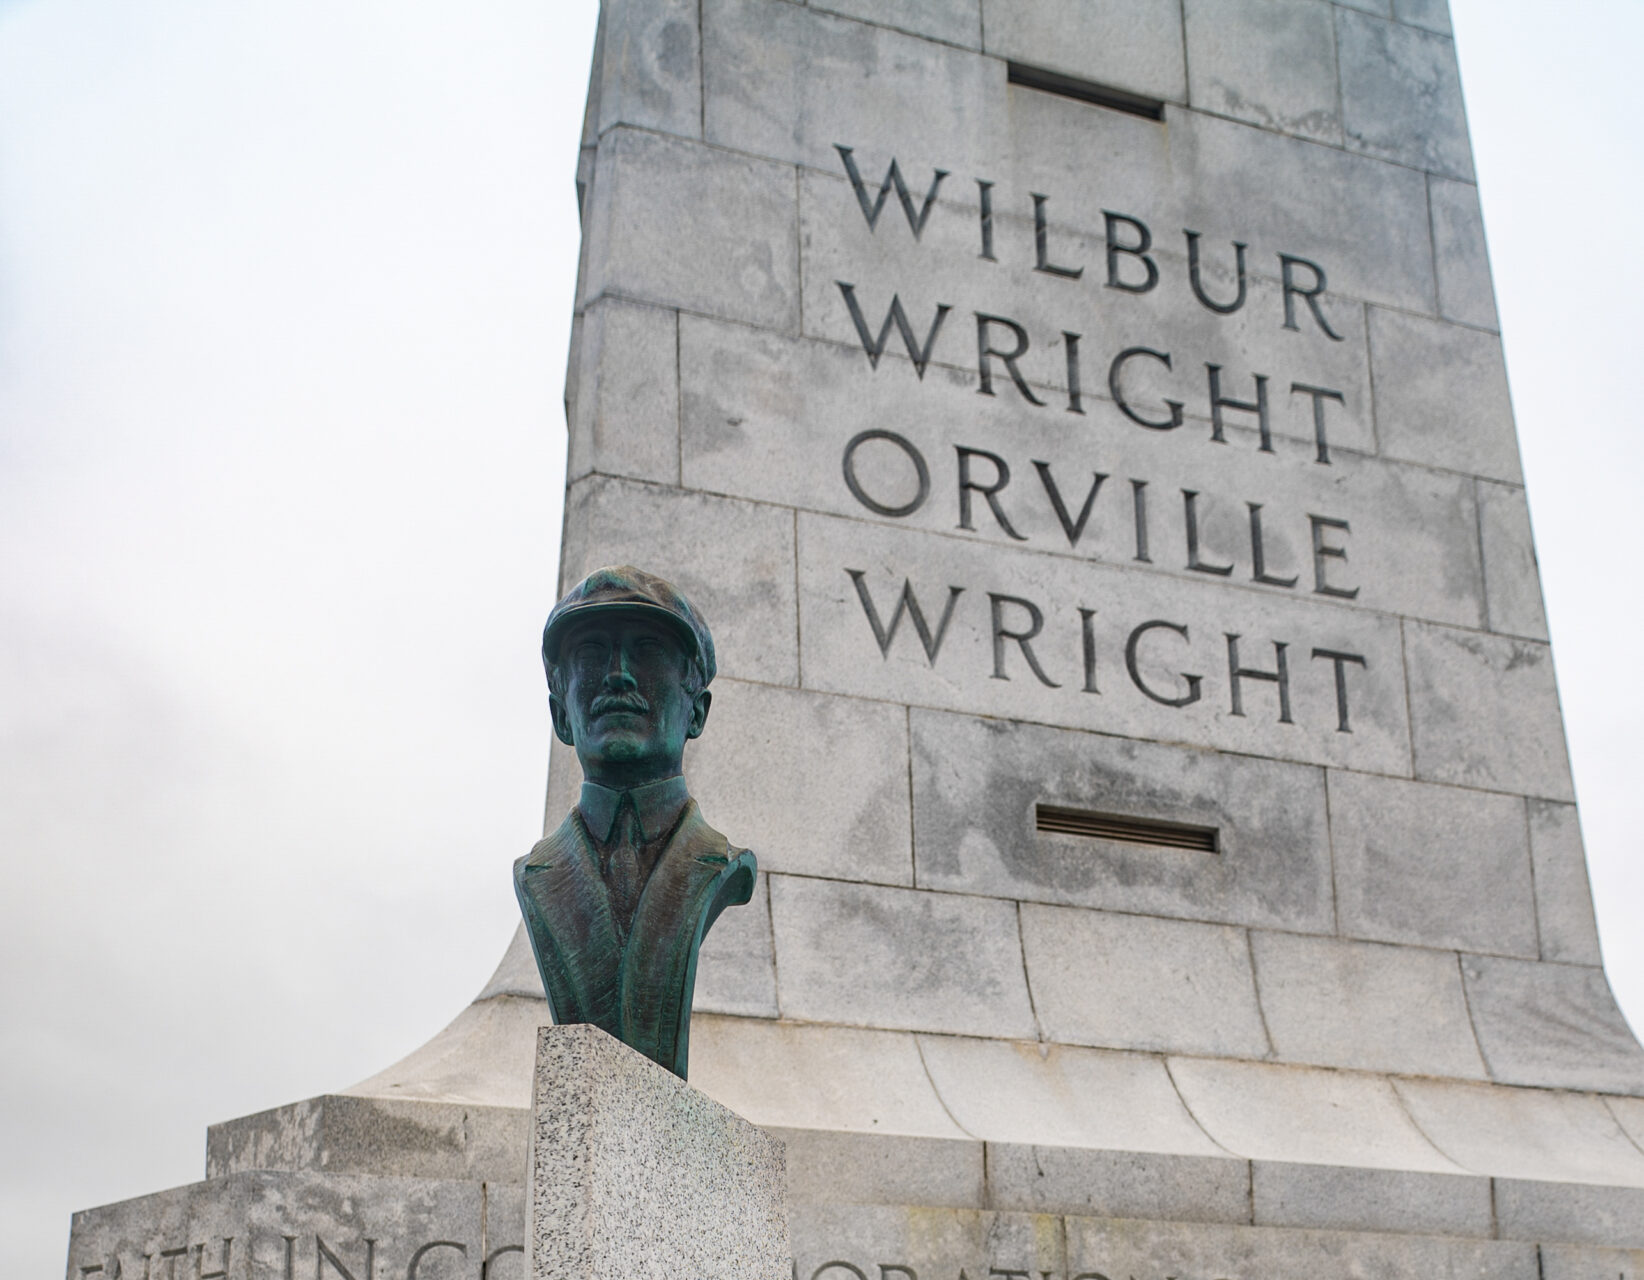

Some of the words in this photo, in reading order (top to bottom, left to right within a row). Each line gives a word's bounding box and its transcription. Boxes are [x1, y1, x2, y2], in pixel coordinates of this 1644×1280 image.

[833, 143, 1345, 342] WILBUR
[834, 280, 1347, 465] WRIGHT
[842, 428, 1360, 600] ORVILLE
[843, 567, 1367, 733] WRIGHT
